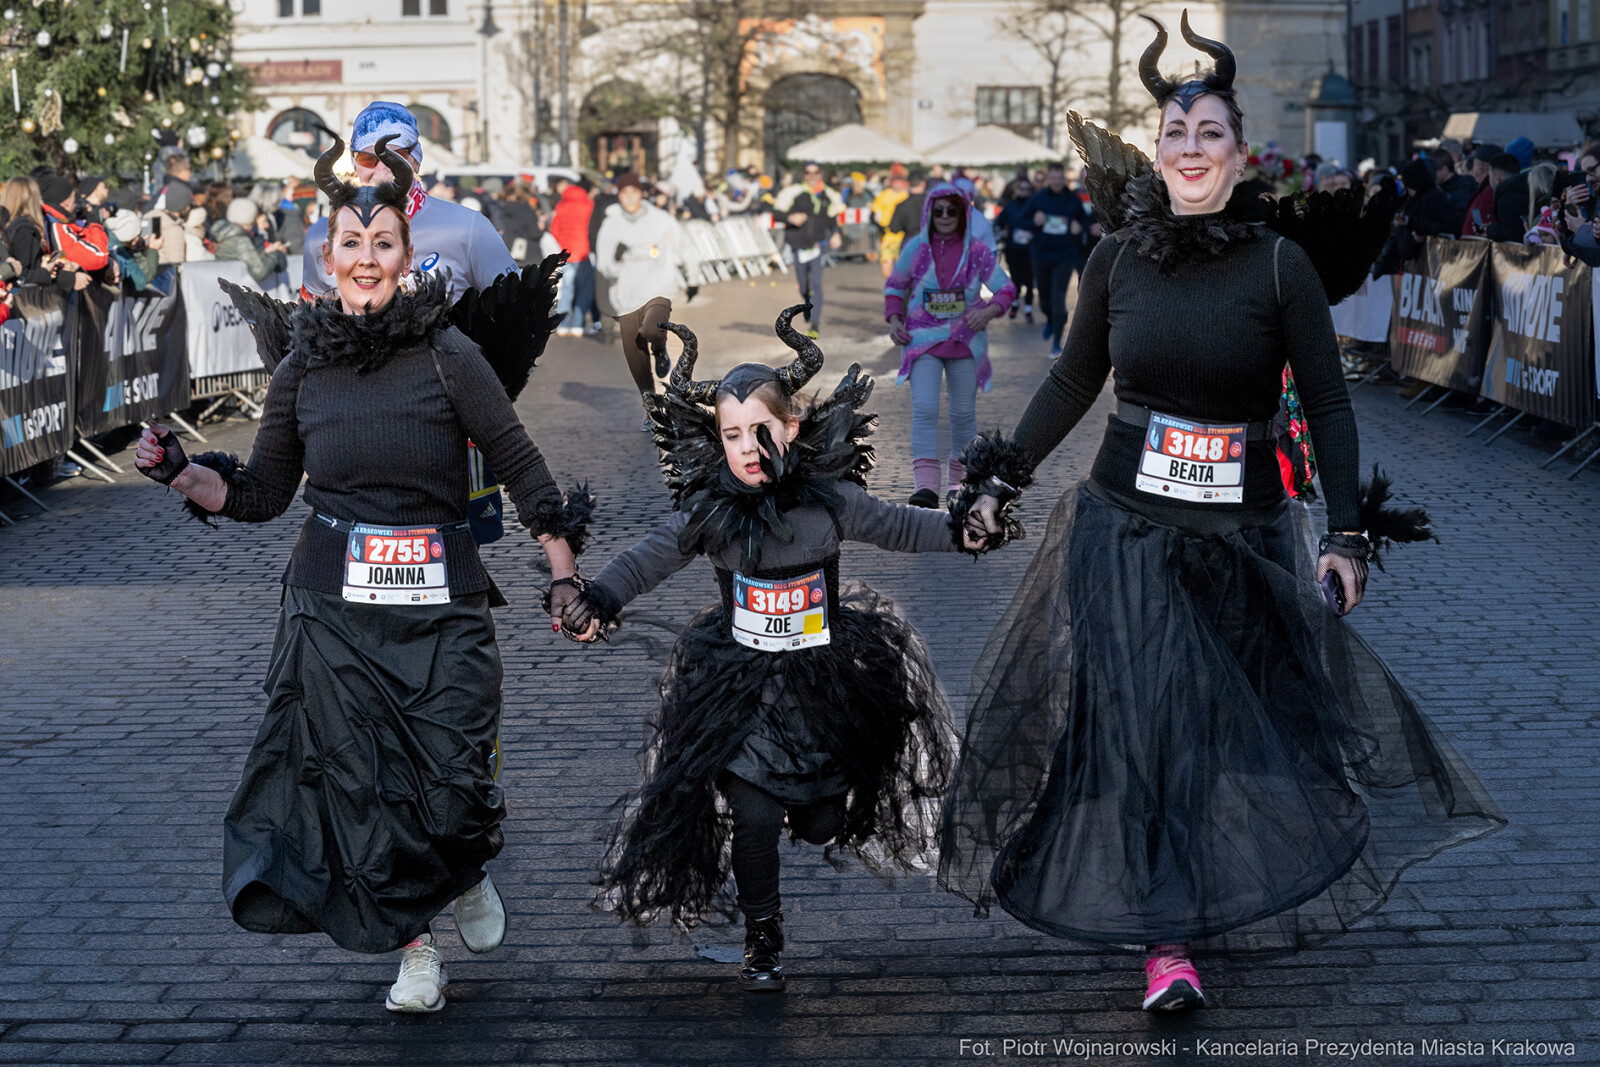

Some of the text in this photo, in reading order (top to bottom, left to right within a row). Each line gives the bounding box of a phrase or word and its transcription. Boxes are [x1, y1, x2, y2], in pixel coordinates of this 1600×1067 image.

[931, 293, 956, 303] 3559
[1168, 431, 1224, 461] 3148
[1169, 460, 1214, 483] BEATA
[369, 538, 426, 562] 2755
[367, 566, 425, 585] JOANNA
[752, 588, 805, 613] 3149
[764, 616, 791, 634] ZOE
